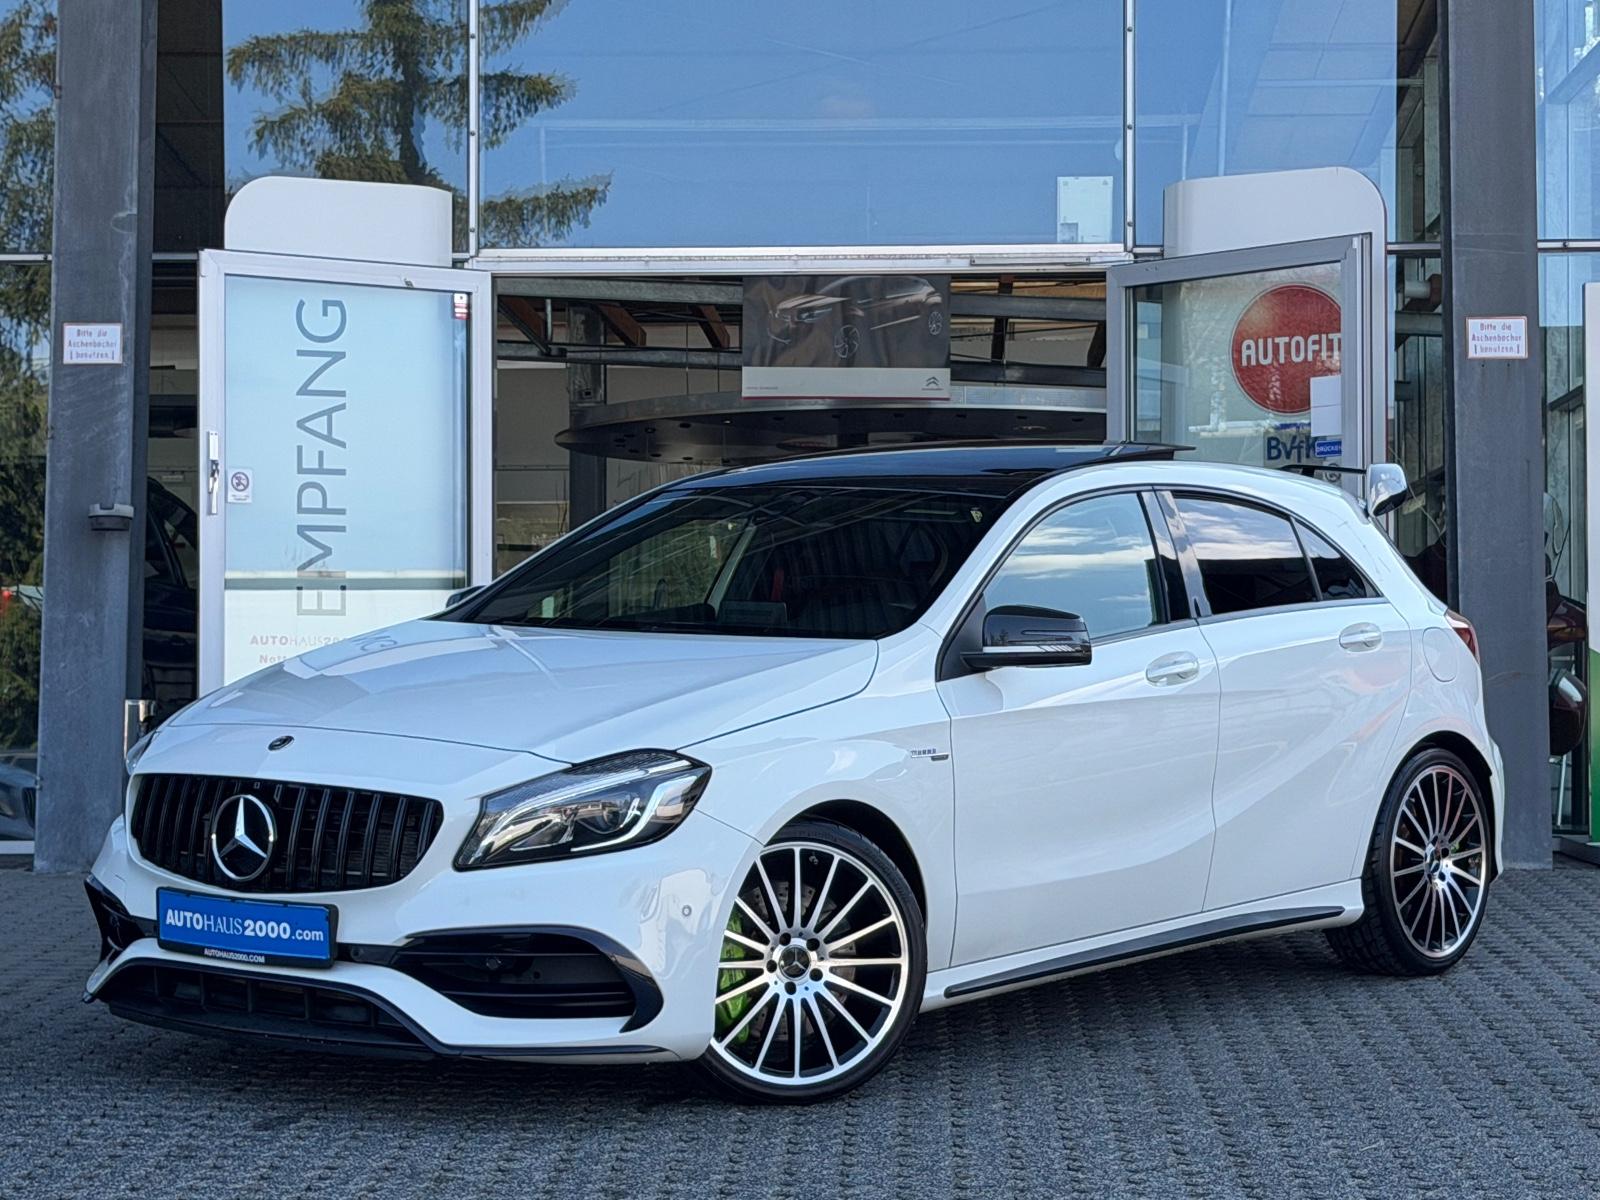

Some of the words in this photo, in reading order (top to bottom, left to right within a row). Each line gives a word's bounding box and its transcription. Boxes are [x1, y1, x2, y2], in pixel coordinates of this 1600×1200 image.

[1480, 322, 1496, 331] Bitte
[1241, 333, 1341, 367] AUTOFIT
[296, 299, 346, 616] EMPFANG
[166, 908, 324, 942] AUTOHAUS2000.com
[204, 947, 265, 964] AUTOHAUS2000.COM
